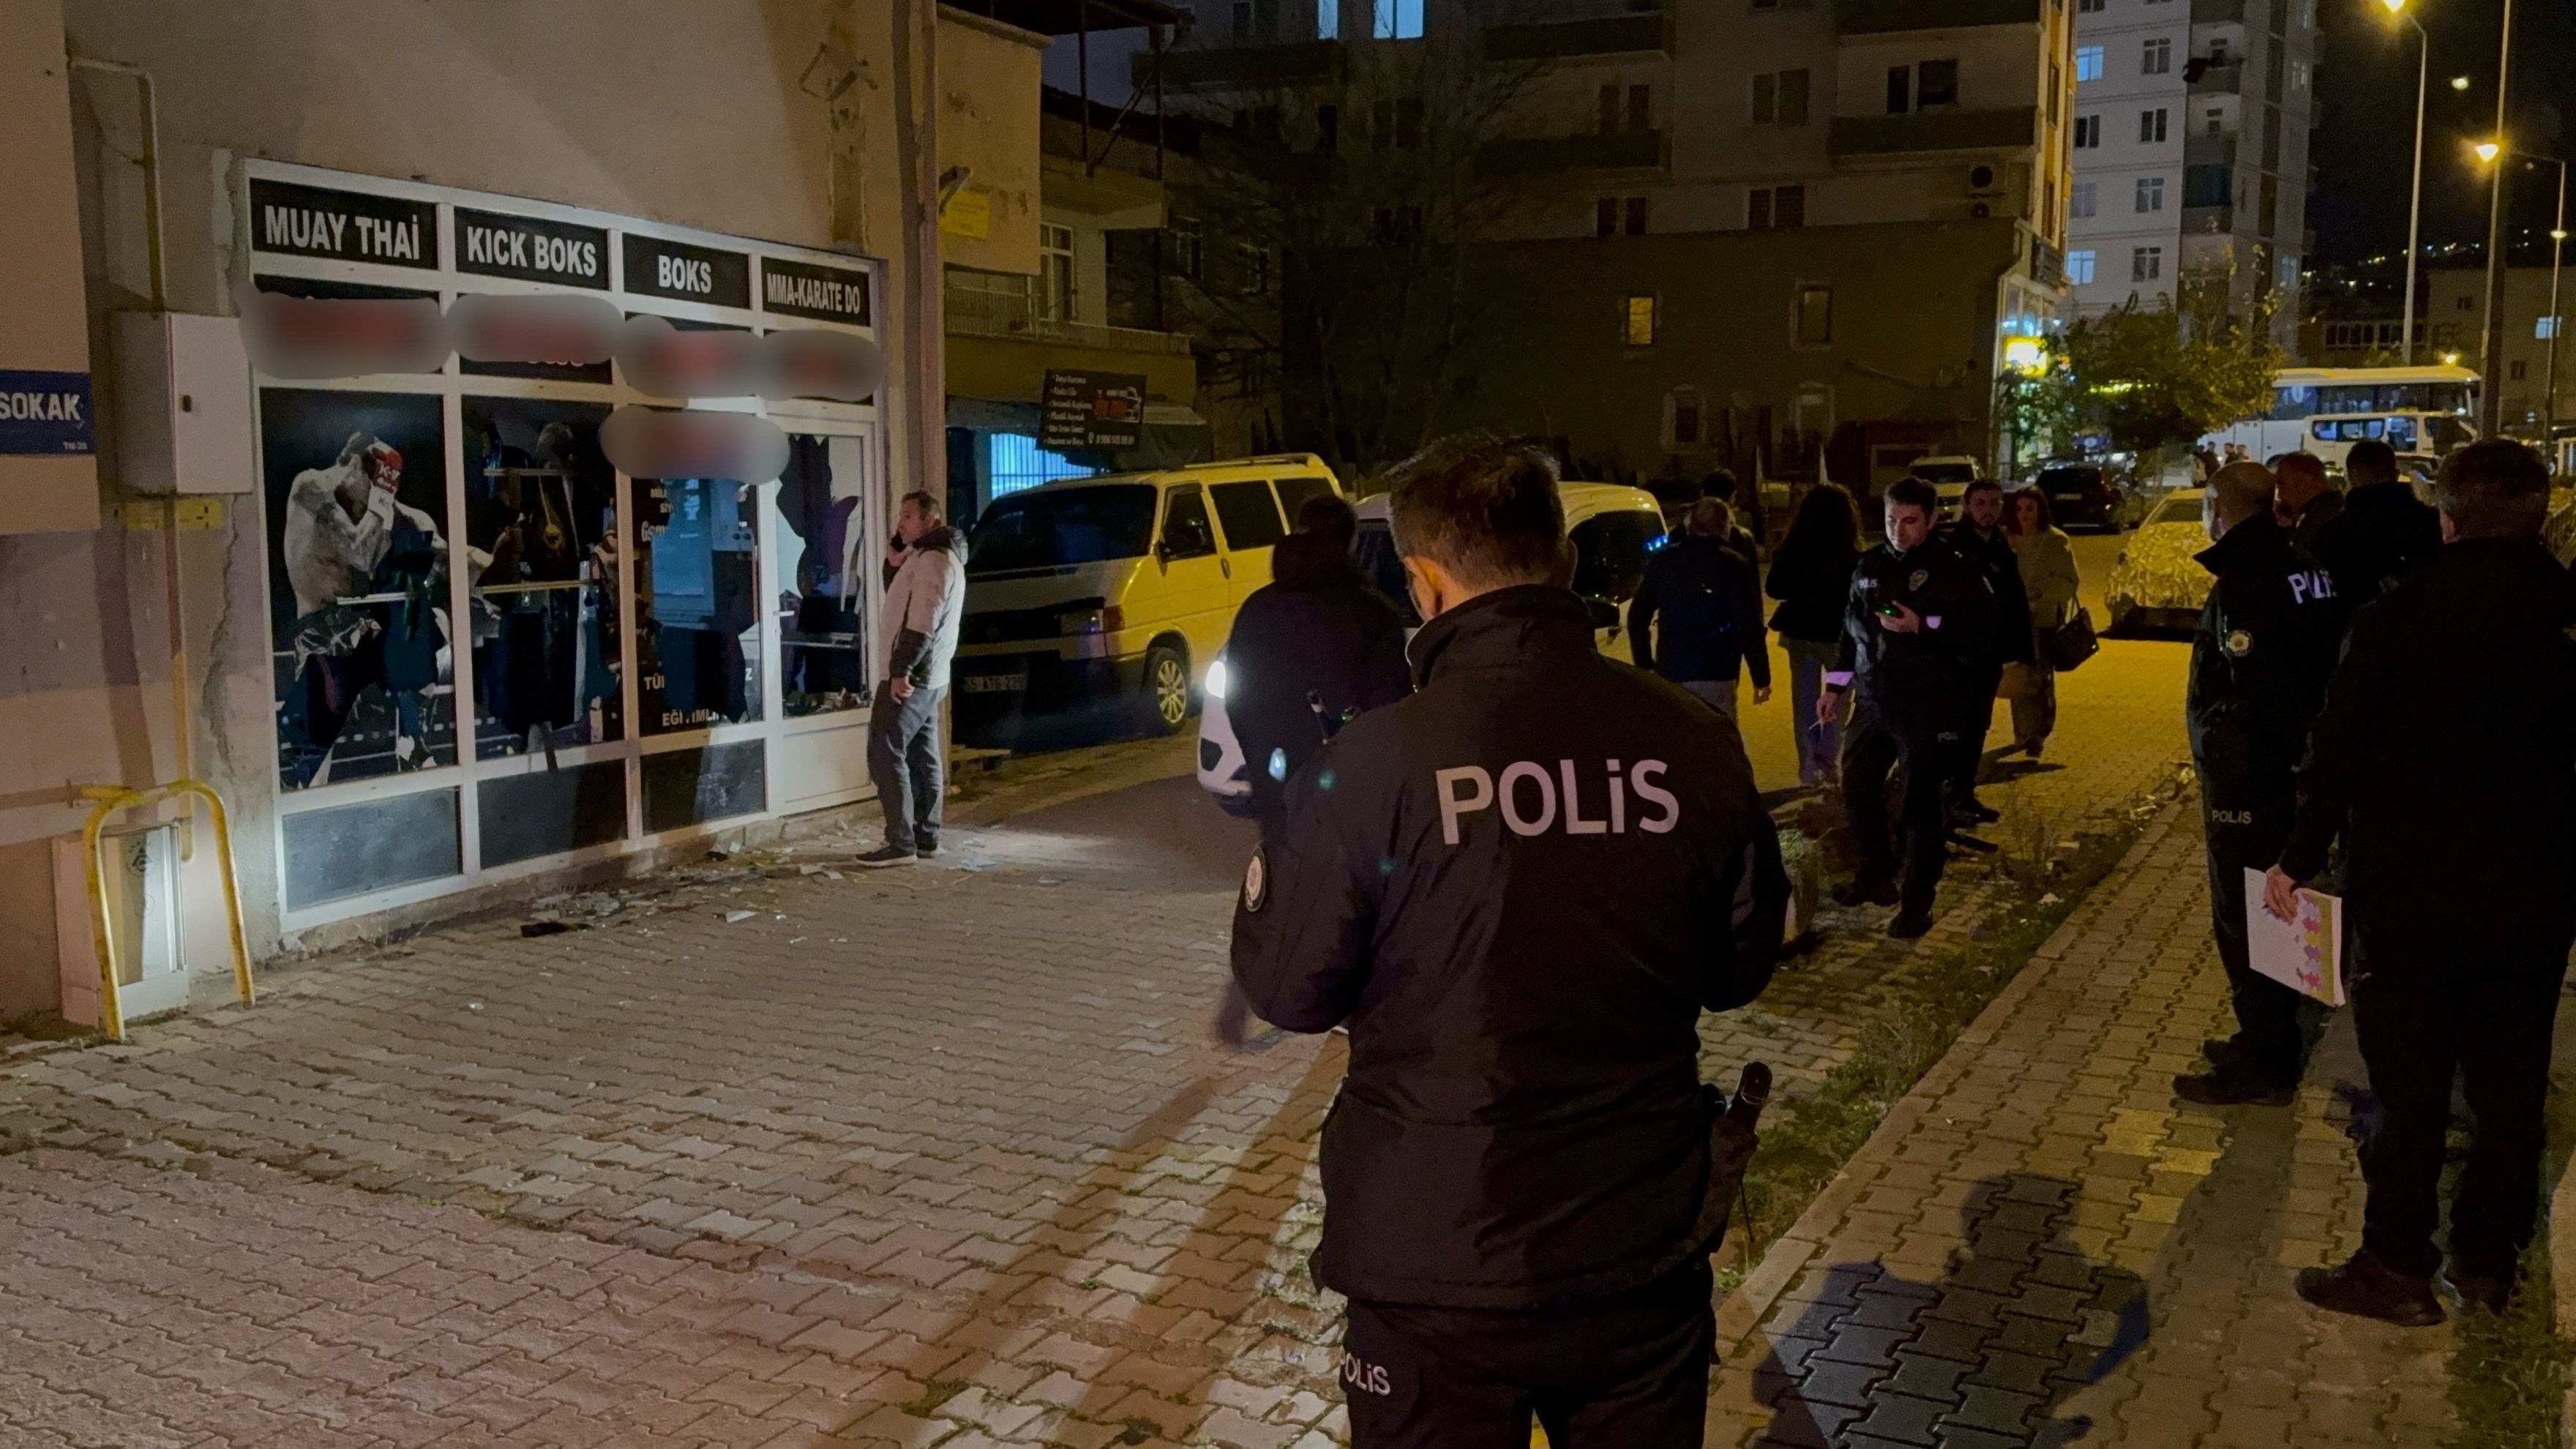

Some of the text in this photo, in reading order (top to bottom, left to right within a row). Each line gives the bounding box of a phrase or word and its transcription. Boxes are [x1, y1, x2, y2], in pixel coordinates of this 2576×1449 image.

[265, 205, 347, 252] MUAY
[467, 226, 597, 277] KICK BOKS
[659, 255, 712, 293] BOKS
[767, 272, 861, 315] MMA-KARATE DO
[0, 392, 81, 421] SOKAK
